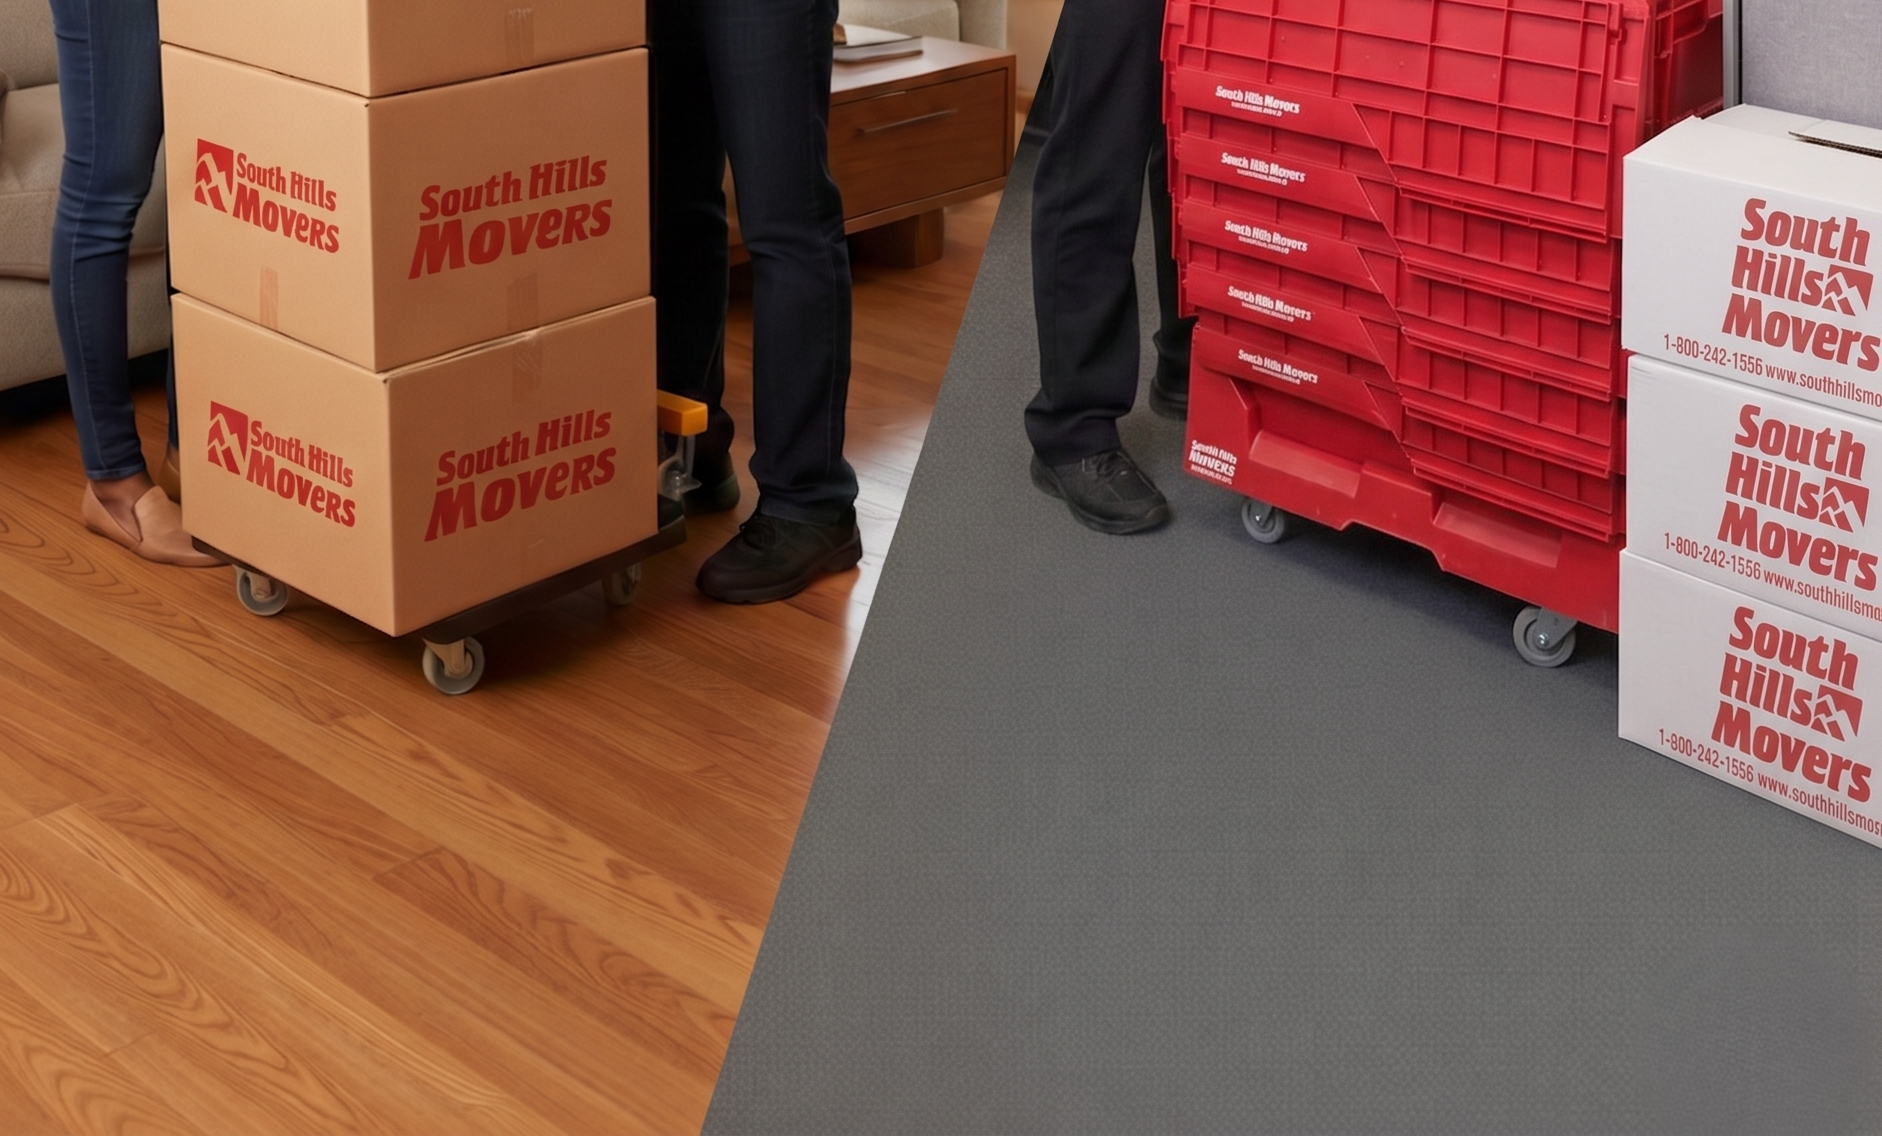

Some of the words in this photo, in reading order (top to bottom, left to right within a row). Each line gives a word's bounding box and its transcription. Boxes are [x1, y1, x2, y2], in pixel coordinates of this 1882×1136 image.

[237, 153, 286, 194] South
[290, 172, 336, 211] Hills
[420, 172, 521, 220] South
[529, 156, 606, 200] Hills
[1741, 199, 1869, 265] South
[1732, 246, 1823, 305] Hills
[1664, 334, 1763, 376] 1-800-242-1556
[1722, 294, 1880, 371] Movers
[250, 420, 304, 467] South
[308, 445, 353, 487] Hills
[437, 431, 529, 486] South
[535, 410, 611, 456] Hills
[1734, 405, 1866, 481] South
[1726, 452, 1819, 519] Hills
[1665, 533, 1761, 580] 1-800-242-1556
[1718, 502, 1877, 590] Movers
[1729, 607, 1858, 689] South
[1720, 654, 1812, 725] Hills
[1660, 729, 1754, 782] 1-800-242-1556
[1712, 702, 1871, 802] Movers
